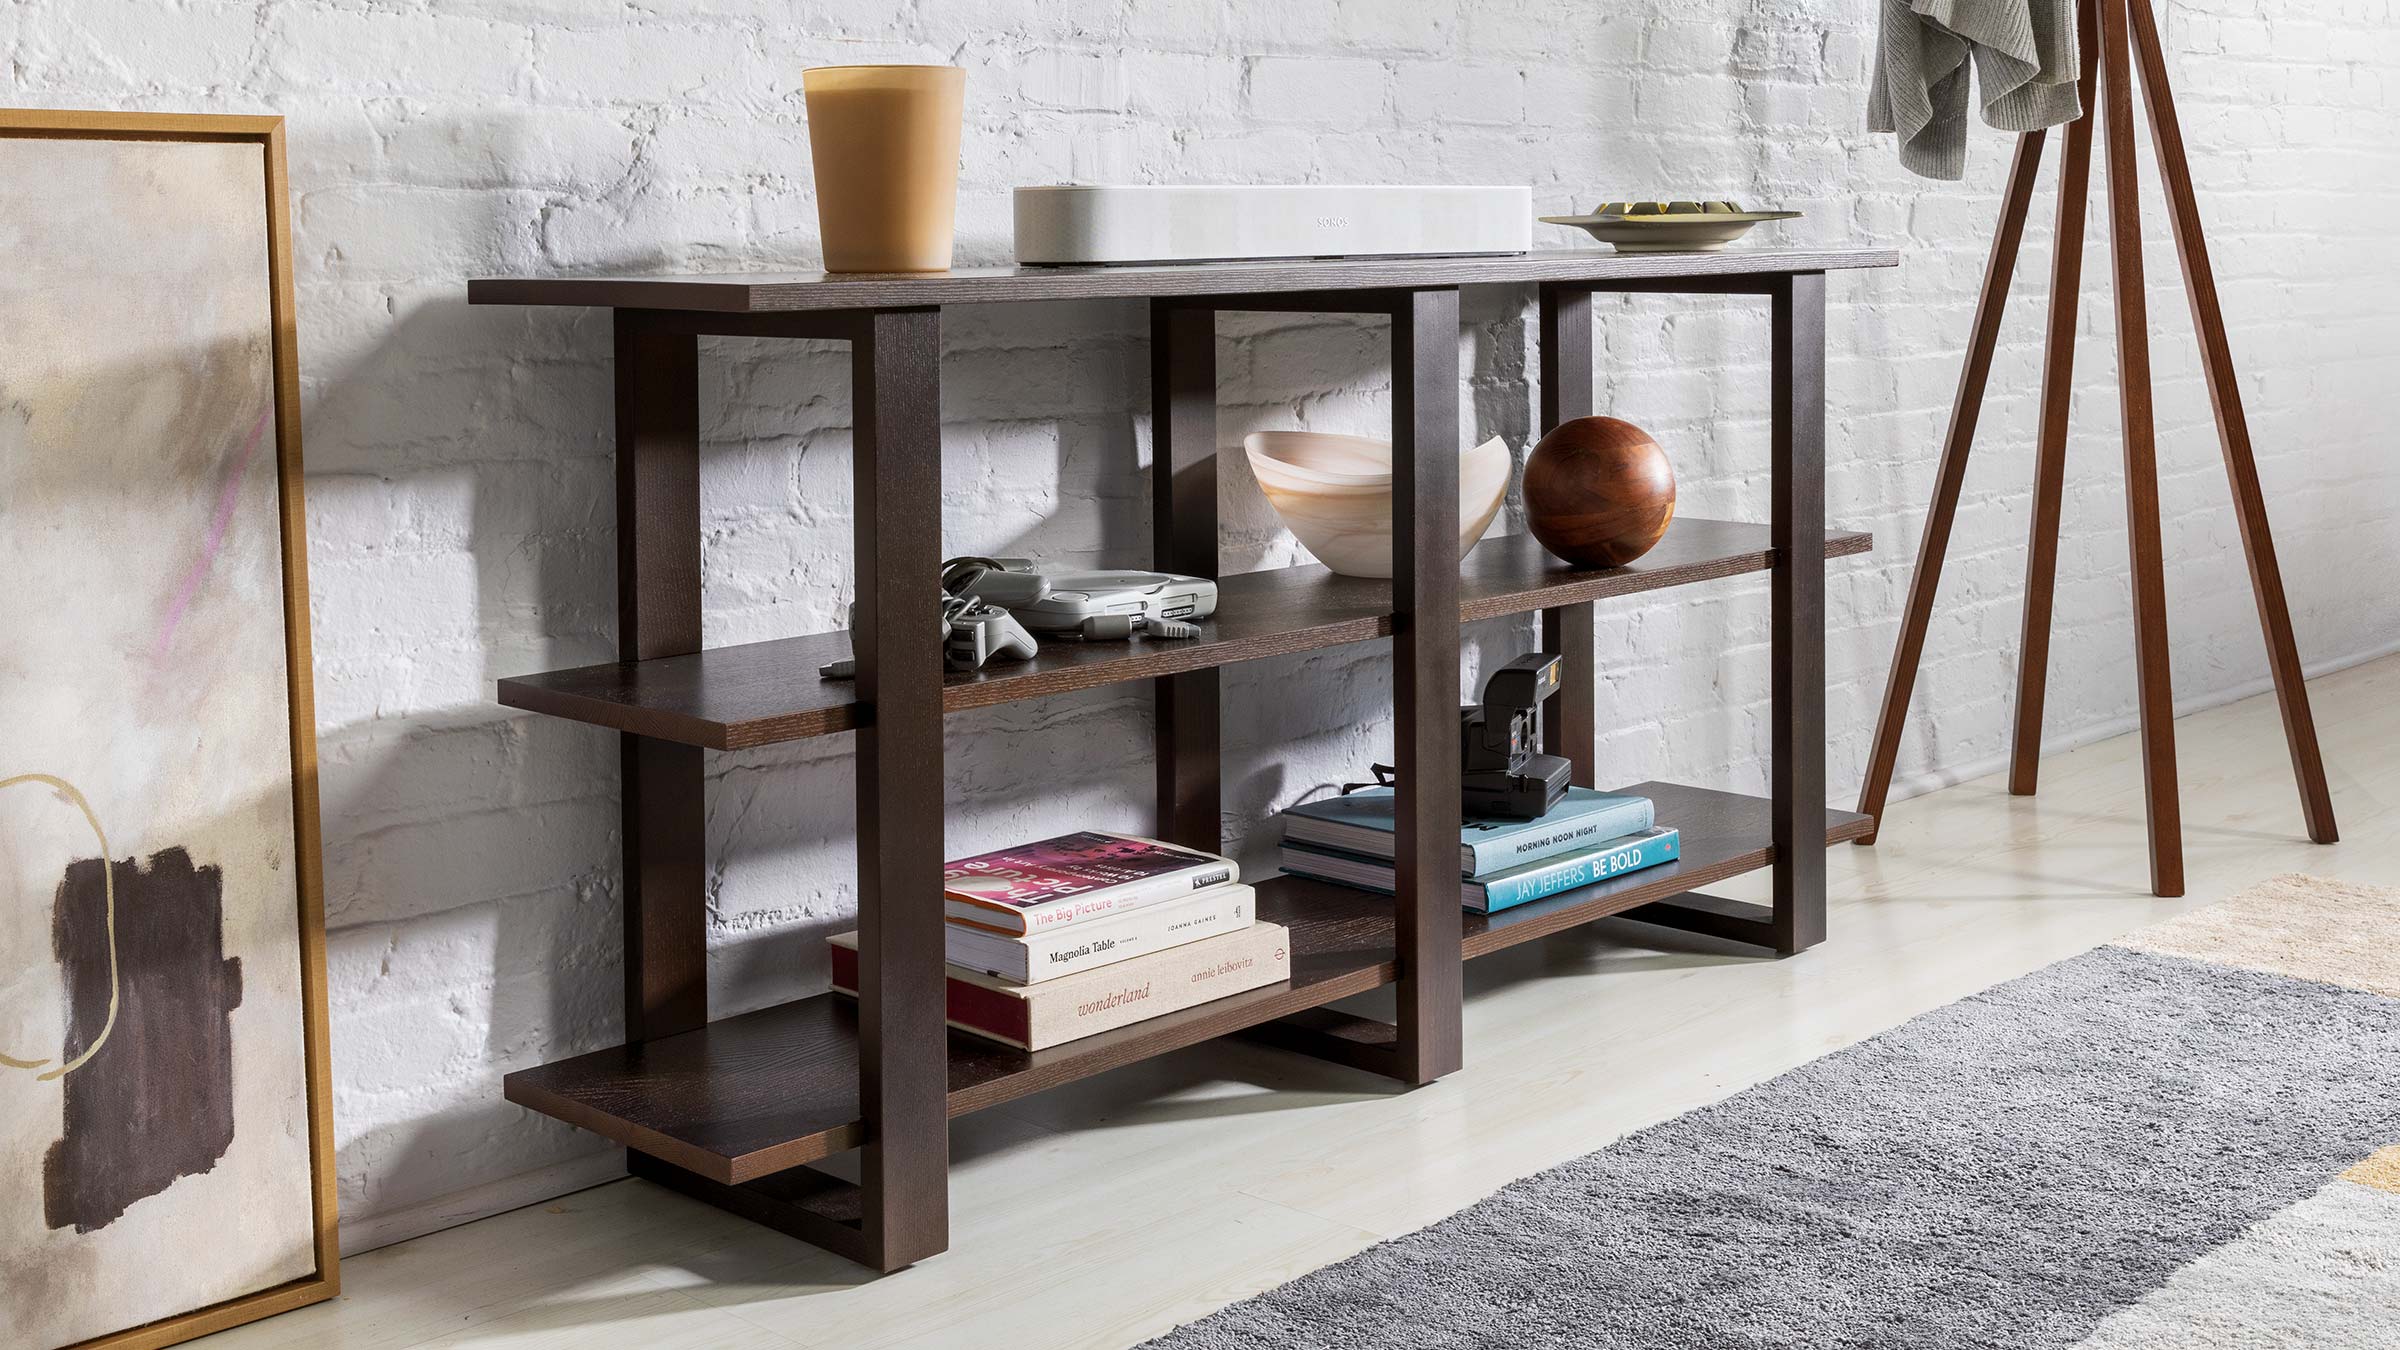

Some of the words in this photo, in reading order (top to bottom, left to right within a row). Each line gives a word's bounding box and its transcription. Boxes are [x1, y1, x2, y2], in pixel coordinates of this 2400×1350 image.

[1317, 216, 1348, 228] SONOS
[1516, 837, 1551, 854] MORNING
[1552, 831, 1574, 844] NOON
[1575, 825, 1598, 838] NIGHT
[964, 861, 1094, 894] Picture
[1201, 872, 1227, 885] PRESTEL
[1516, 878, 1536, 901] JAY
[1538, 865, 1585, 893] JEFFERS
[1592, 858, 1607, 879] BE
[1610, 849, 1642, 872] BOLD
[1034, 913, 1054, 926] The
[1056, 908, 1073, 921] Big
[1075, 898, 1113, 916] Picture
[1167, 921, 1191, 932] JOANNA
[1194, 914, 1217, 926] GAINES
[1049, 945, 1090, 964] Magnolia
[1092, 939, 1116, 953] Table
[1191, 968, 1216, 983] annie
[1217, 957, 1254, 976] leibovitz
[1078, 982, 1151, 1017] wonderland
